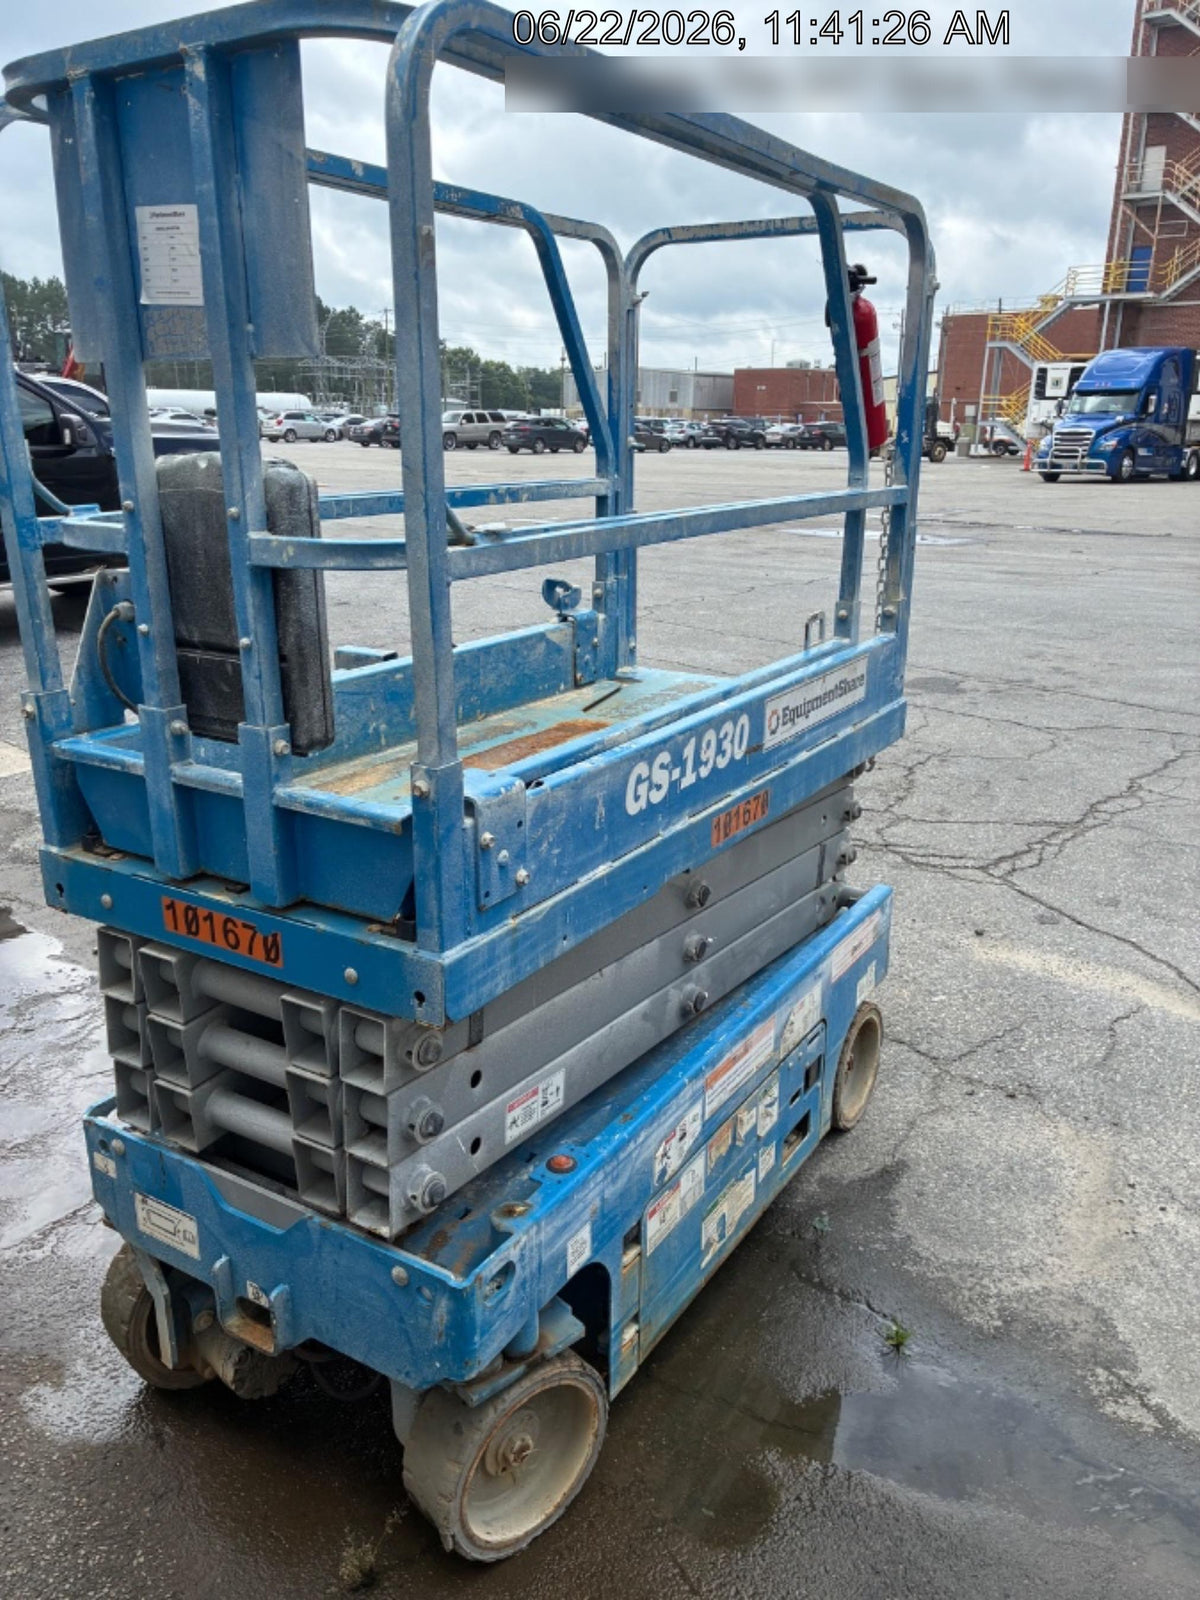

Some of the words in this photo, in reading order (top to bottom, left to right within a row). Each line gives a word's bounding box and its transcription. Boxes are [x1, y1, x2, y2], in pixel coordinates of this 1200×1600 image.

[781, 673, 865, 726] EquipmentShare
[625, 714, 749, 816] GS-1930
[713, 789, 769, 844] 101670
[165, 900, 280, 964] 101670
